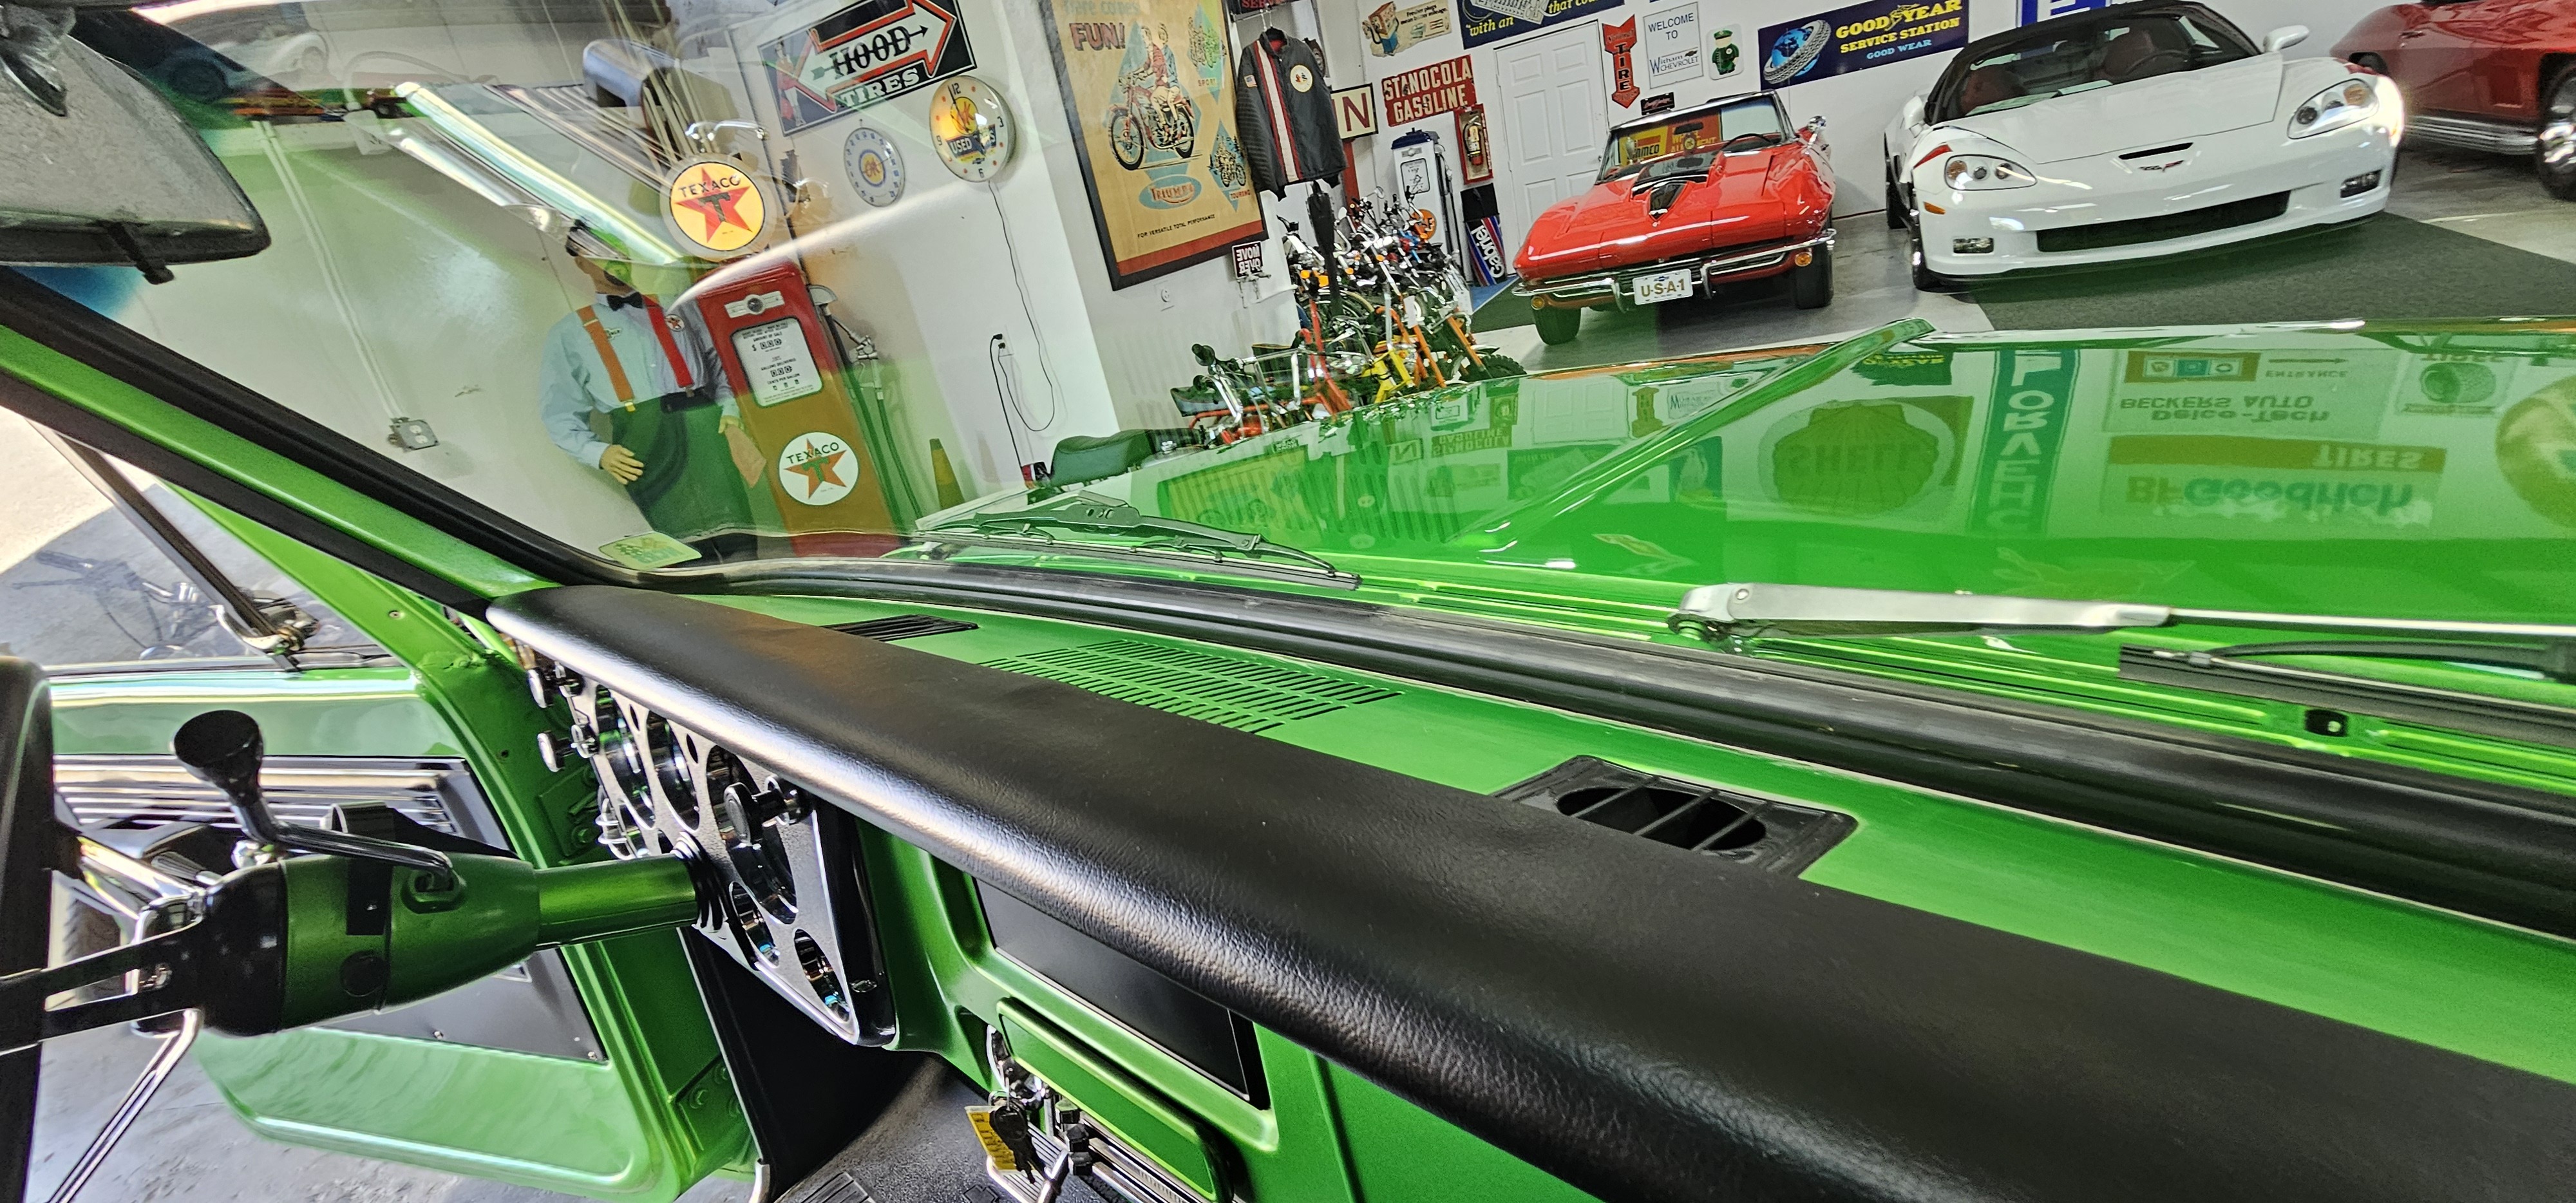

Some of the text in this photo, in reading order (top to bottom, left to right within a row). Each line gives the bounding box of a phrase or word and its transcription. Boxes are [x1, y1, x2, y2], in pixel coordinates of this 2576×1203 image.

[1499, 16, 1514, 28] an
[1648, 13, 1694, 33] WELCOME
[1069, 23, 1126, 51] FUN!
[1665, 30, 1678, 40] TO
[1840, 17, 1961, 53] SERVICE STATION
[830, 26, 911, 79] HOOD
[1866, 39, 1933, 59] GOOD WEAR
[1615, 43, 1630, 90] TIRE
[1660, 56, 1699, 72] CHEVROLET
[839, 68, 920, 108] TIRES
[951, 82, 961, 95] 12
[1383, 58, 1473, 101] STANOCOLA
[1393, 84, 1468, 123] GASOLINE
[997, 116, 1004, 128] 3
[936, 135, 942, 146] 9
[950, 137, 973, 154] USED
[978, 167, 985, 178] 6
[678, 175, 741, 198] TEXACO
[697, 192, 732, 223] T
[1137, 231, 1148, 239] FOR
[1150, 225, 1173, 236] VERSATILE
[1173, 222, 1186, 230] TOTAL
[1471, 225, 1504, 278] Gabriel
[786, 442, 839, 464] TEXACO
[801, 456, 829, 482] T
